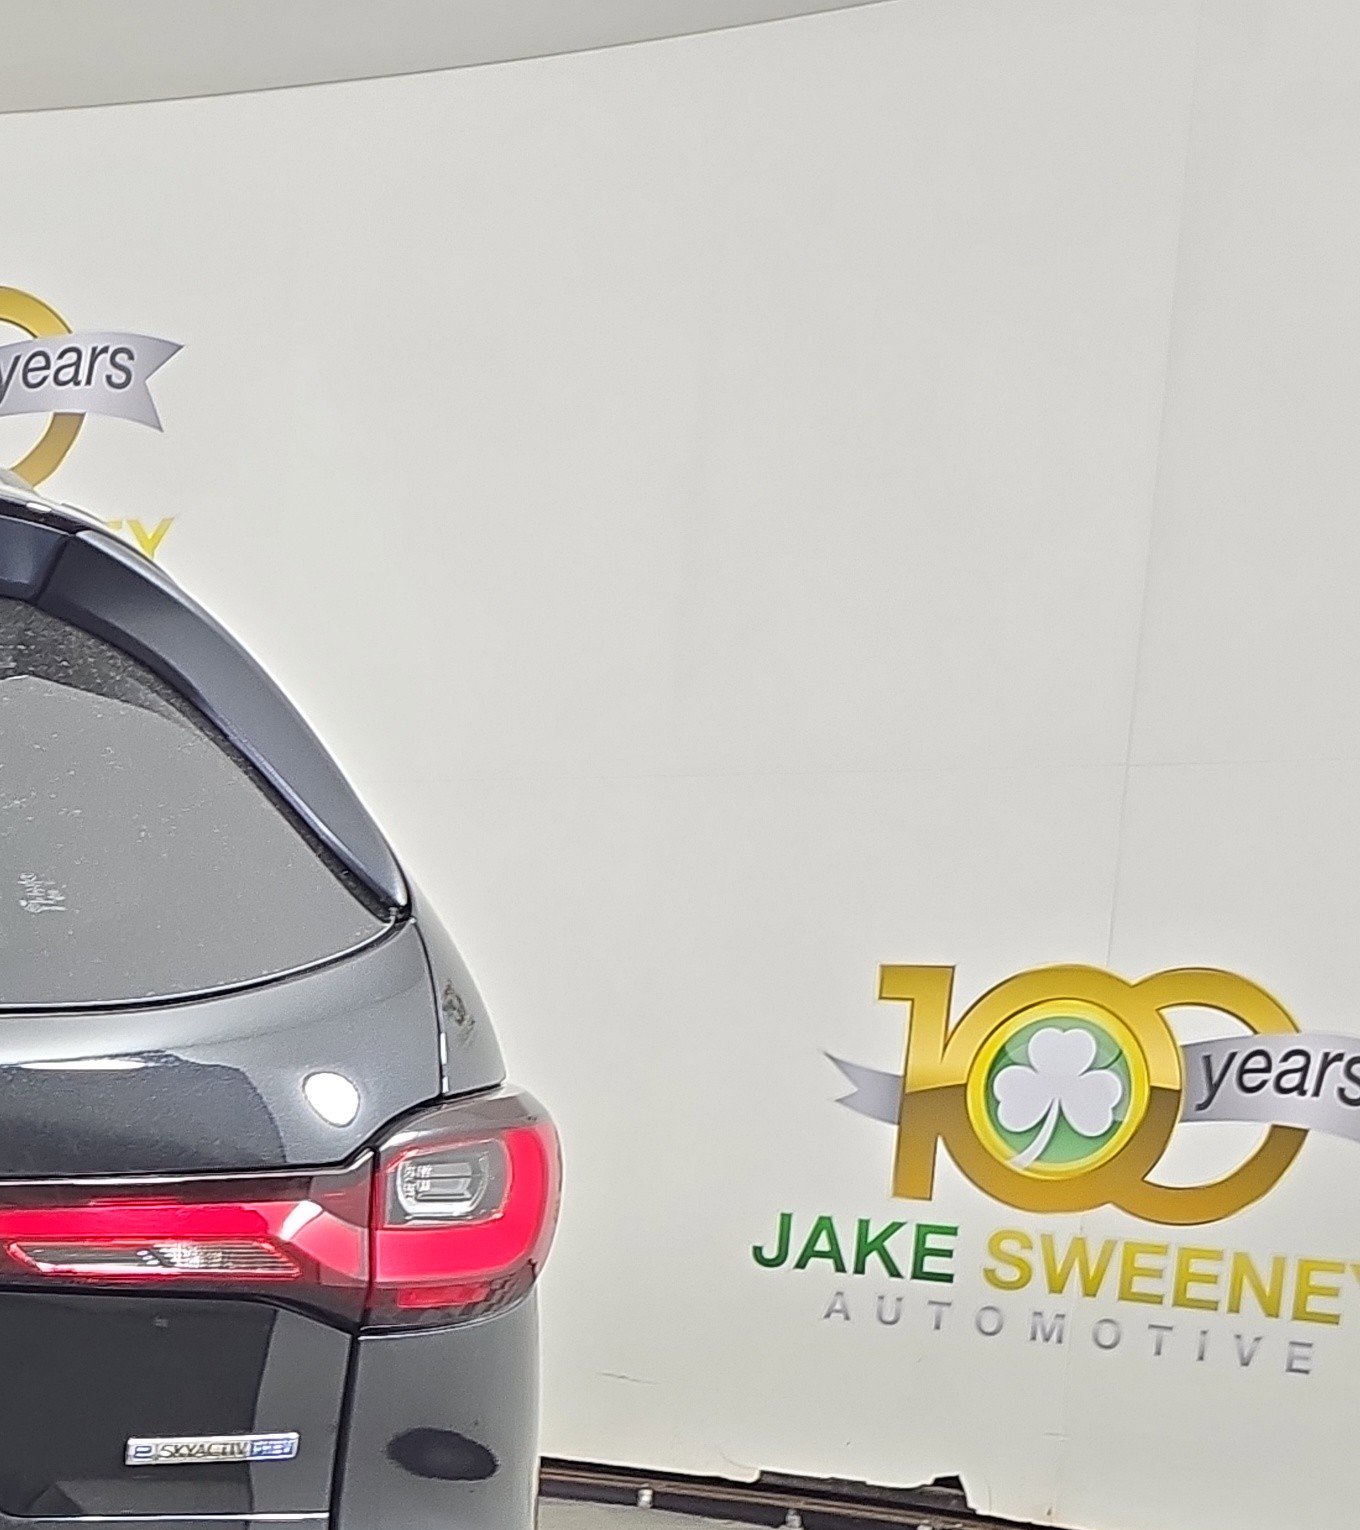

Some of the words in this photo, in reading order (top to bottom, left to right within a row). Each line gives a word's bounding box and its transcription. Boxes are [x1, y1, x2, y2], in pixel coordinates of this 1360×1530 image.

[879, 964, 1312, 1226] 100
[1194, 1048, 1360, 1112] years
[752, 1212, 960, 1283] JAKE
[982, 1228, 1360, 1325] SWEENE
[823, 1291, 1314, 1375] AUTOMOTIVE
